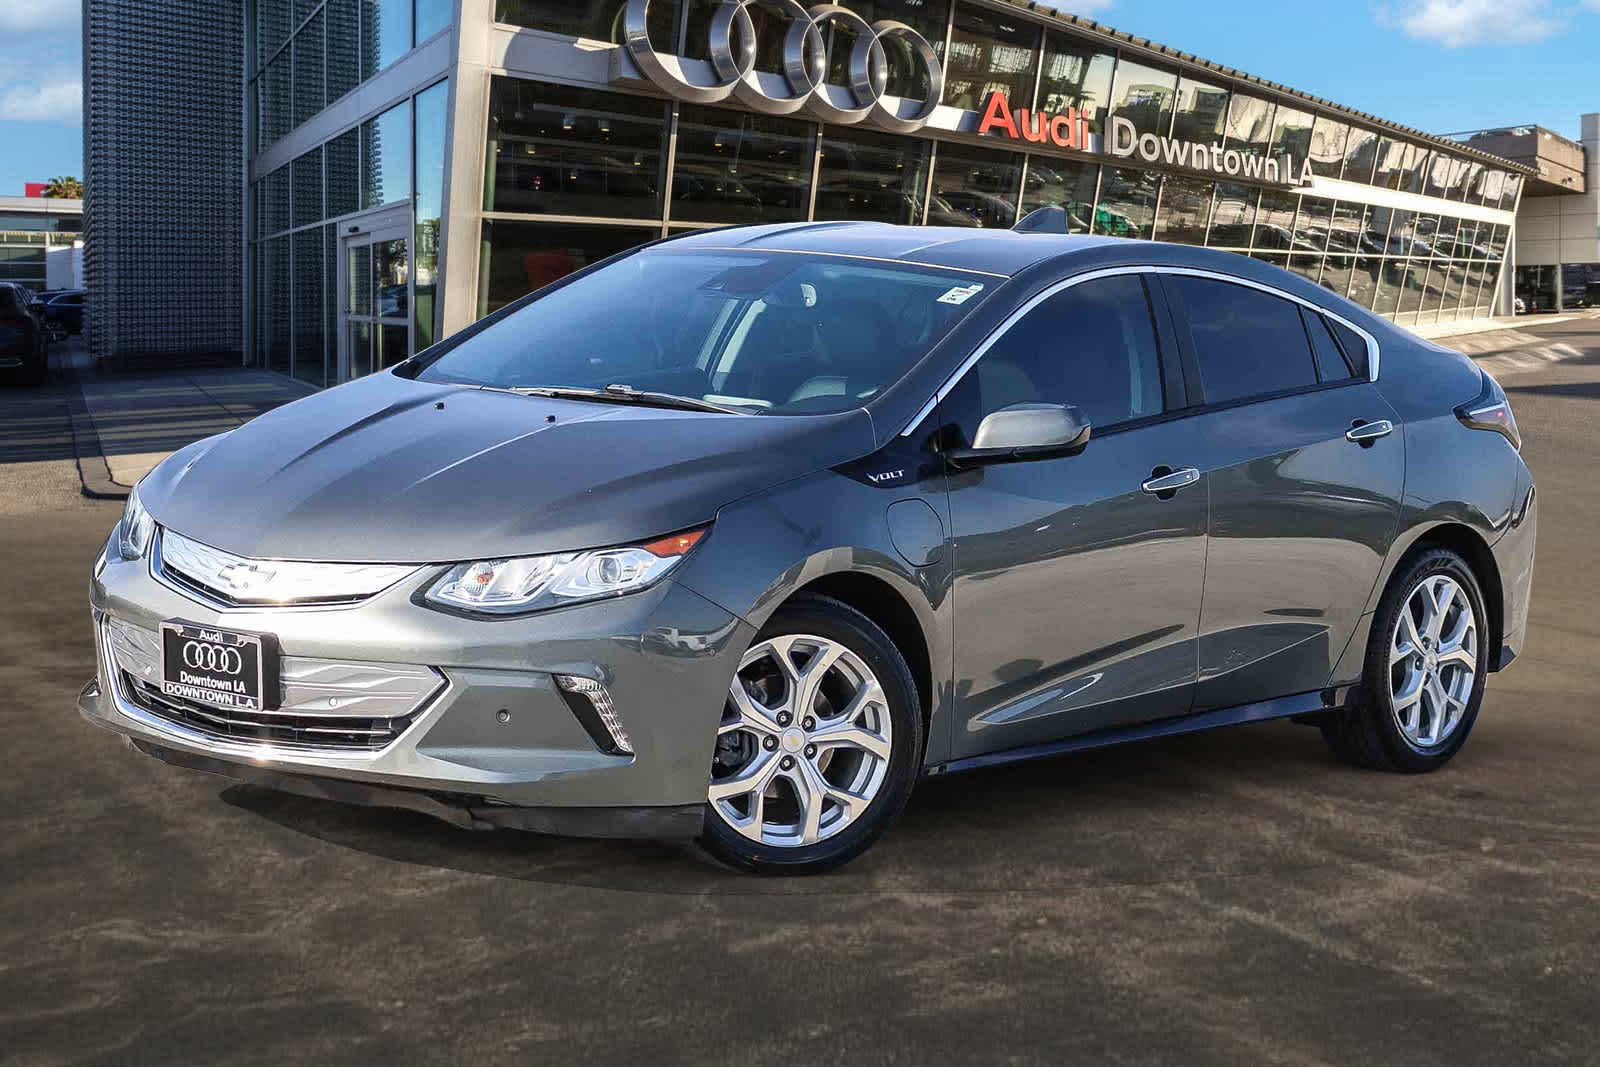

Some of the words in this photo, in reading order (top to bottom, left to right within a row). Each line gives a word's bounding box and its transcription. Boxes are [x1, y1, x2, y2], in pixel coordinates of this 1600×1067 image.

[978, 91, 1089, 150] Audi
[1107, 115, 1280, 183] Downtown
[1286, 153, 1316, 188] LA
[866, 469, 905, 483] VOLT
[199, 629, 224, 642] Audi
[166, 682, 234, 705] DOWNTOWN
[180, 670, 232, 692] Downtown
[233, 679, 246, 694] LA
